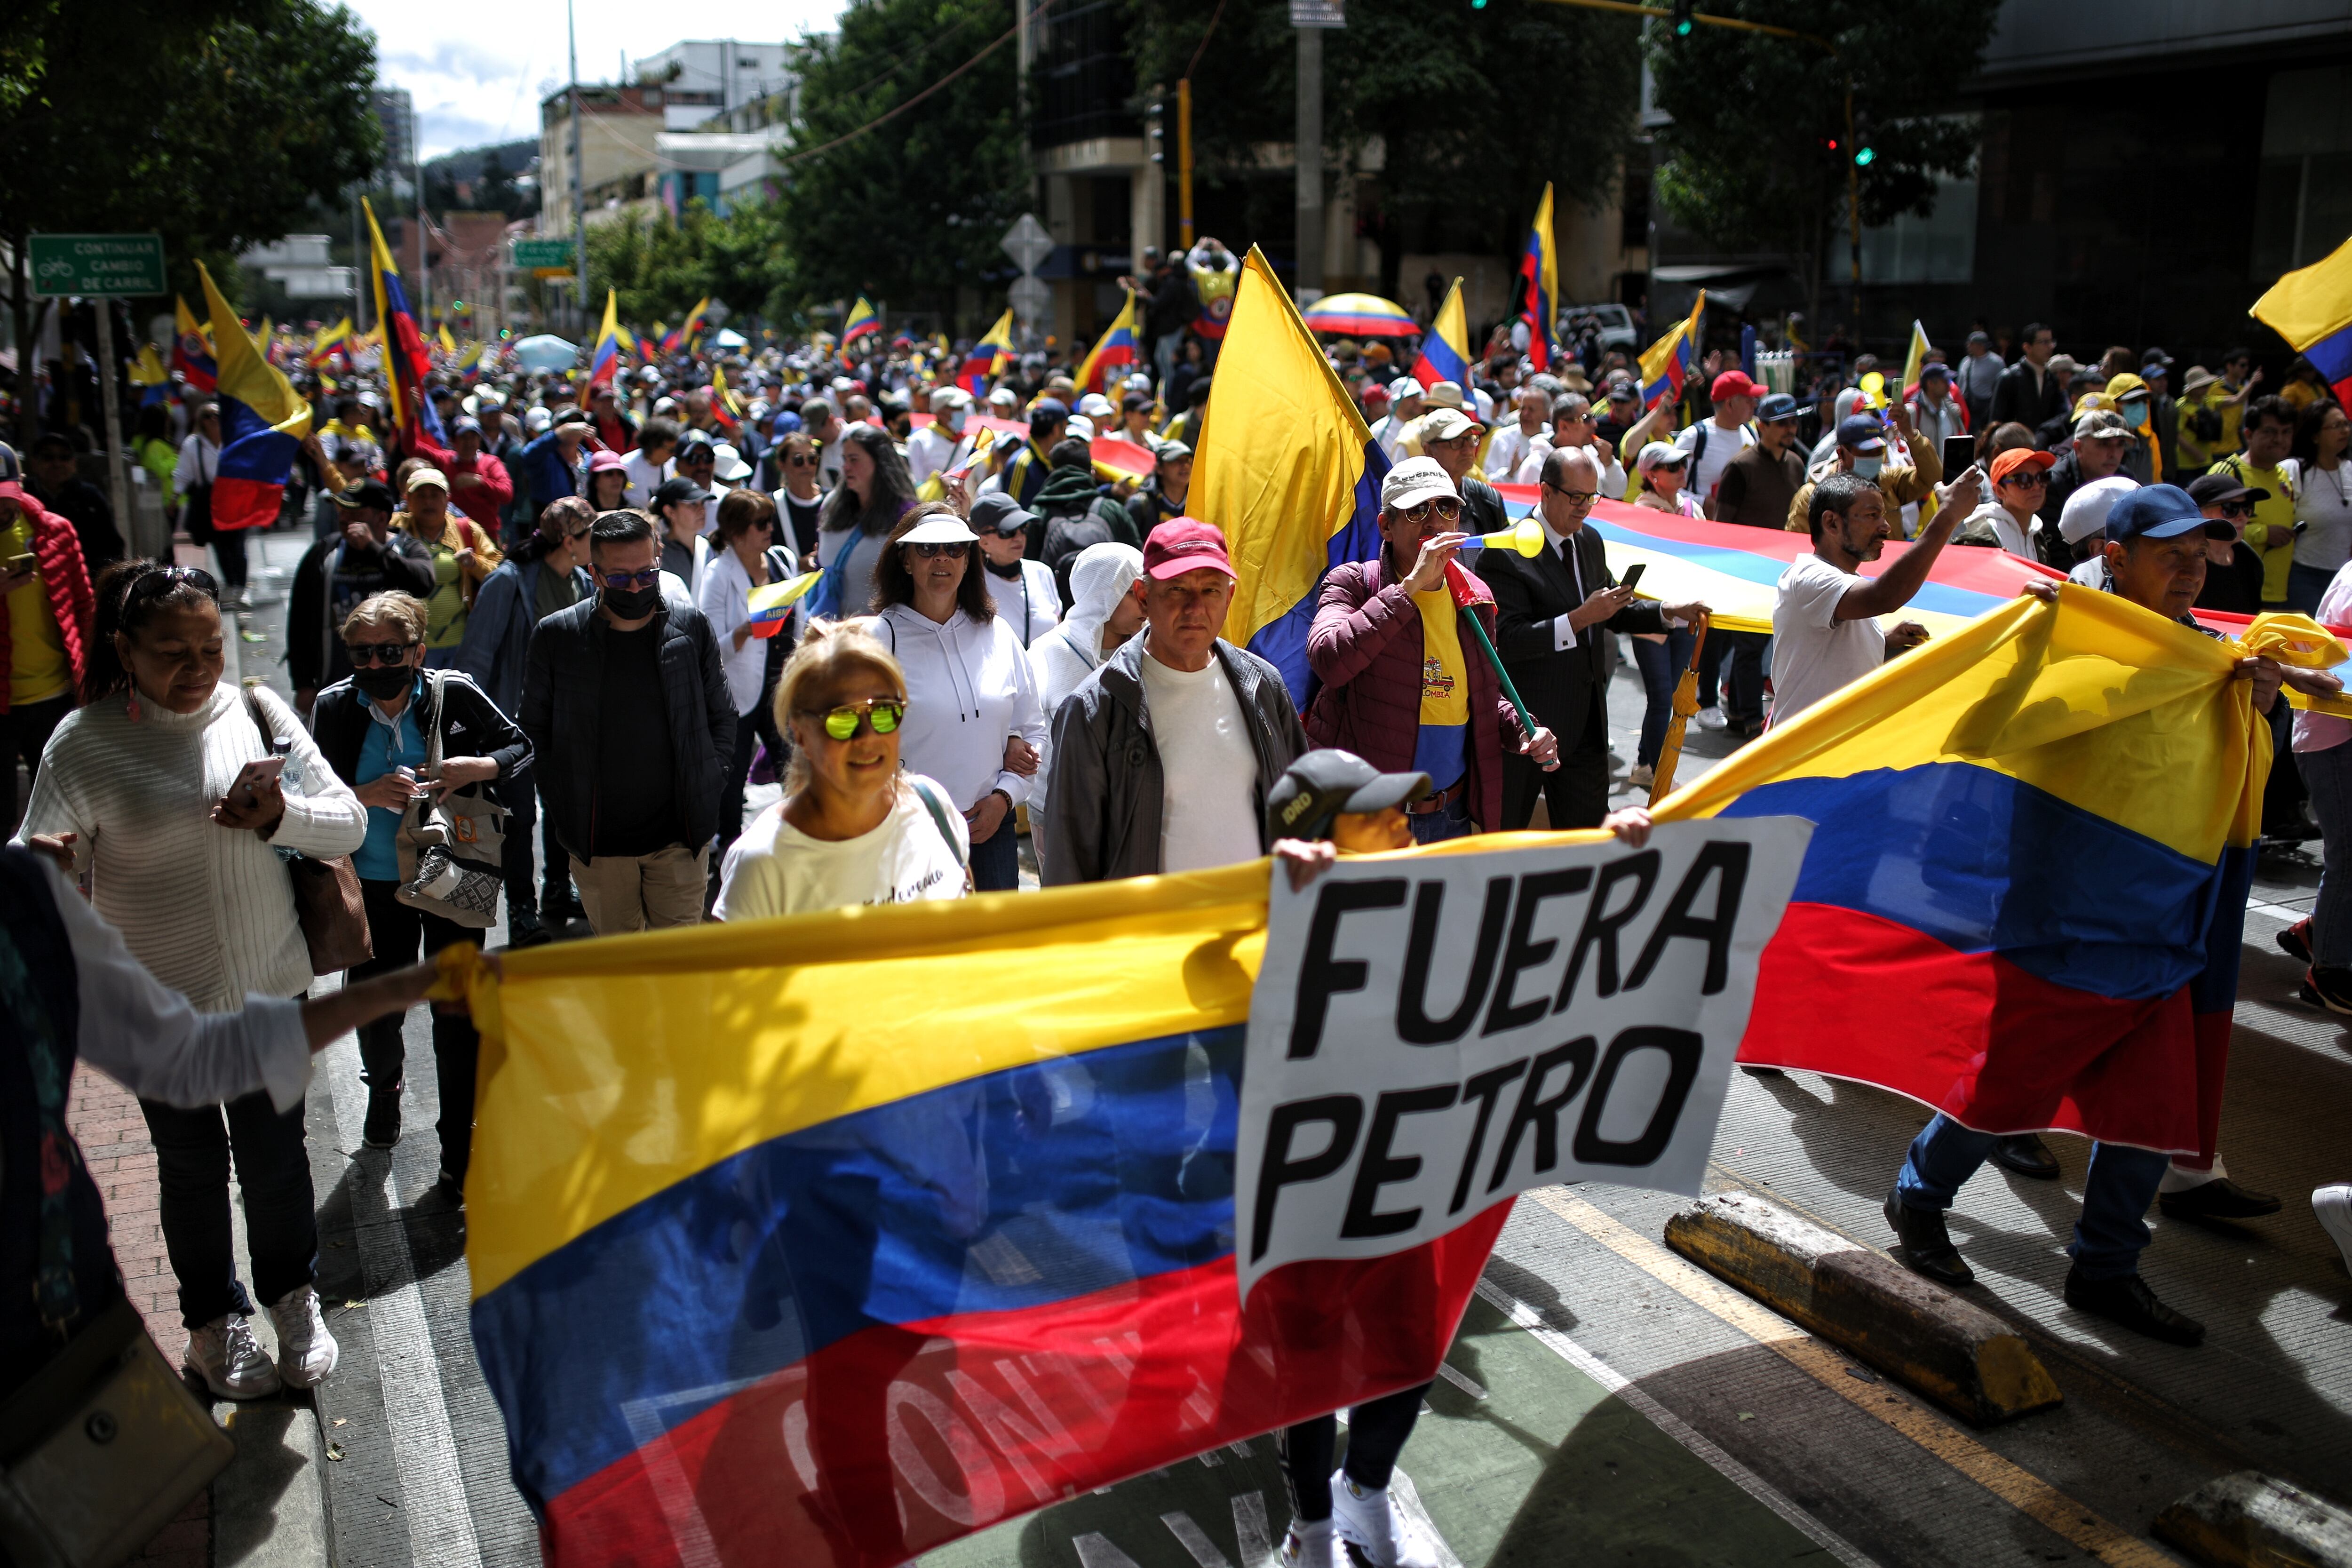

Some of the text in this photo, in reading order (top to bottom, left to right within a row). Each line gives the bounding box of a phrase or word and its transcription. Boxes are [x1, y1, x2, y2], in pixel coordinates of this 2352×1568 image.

[74, 242, 155, 255] CONTINUAR
[90, 259, 144, 272] CAMBIO
[81, 277, 156, 290] DE CARRIL
[449, 726, 466, 735] adidas
[1281, 791, 1312, 826] IDRD
[1286, 840, 1752, 1061] FUERA
[1249, 1026, 1704, 1267] PETRO
